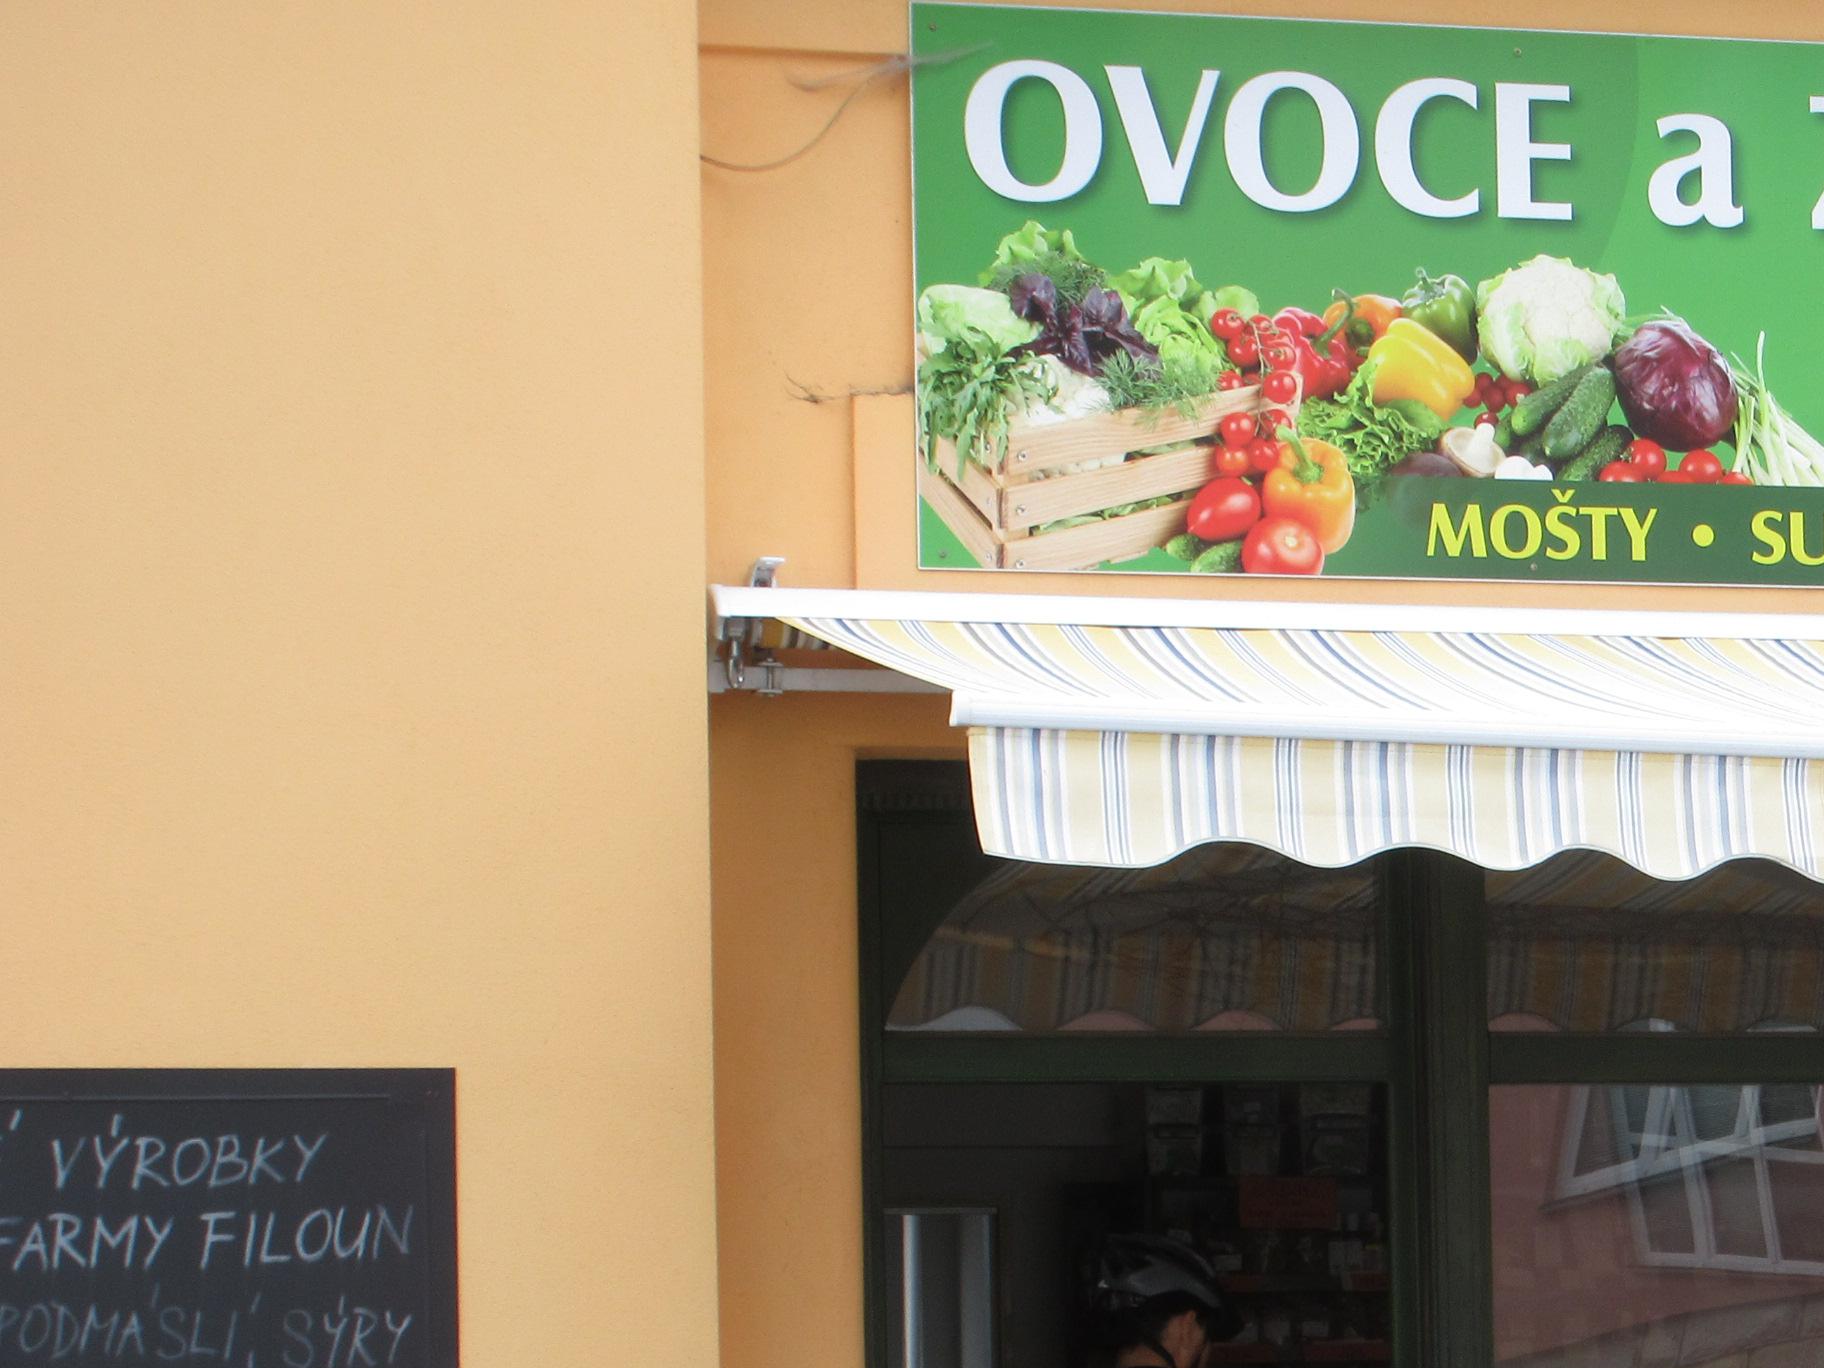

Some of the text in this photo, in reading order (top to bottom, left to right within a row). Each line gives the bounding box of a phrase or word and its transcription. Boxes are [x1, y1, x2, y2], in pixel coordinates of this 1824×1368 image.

[965, 59, 1574, 220] OVOCE
[1647, 113, 1744, 229] a
[1427, 490, 1658, 563] MOŠTY
[51, 1113, 329, 1190] VÝROBKY
[200, 1204, 414, 1271] FILOUN
